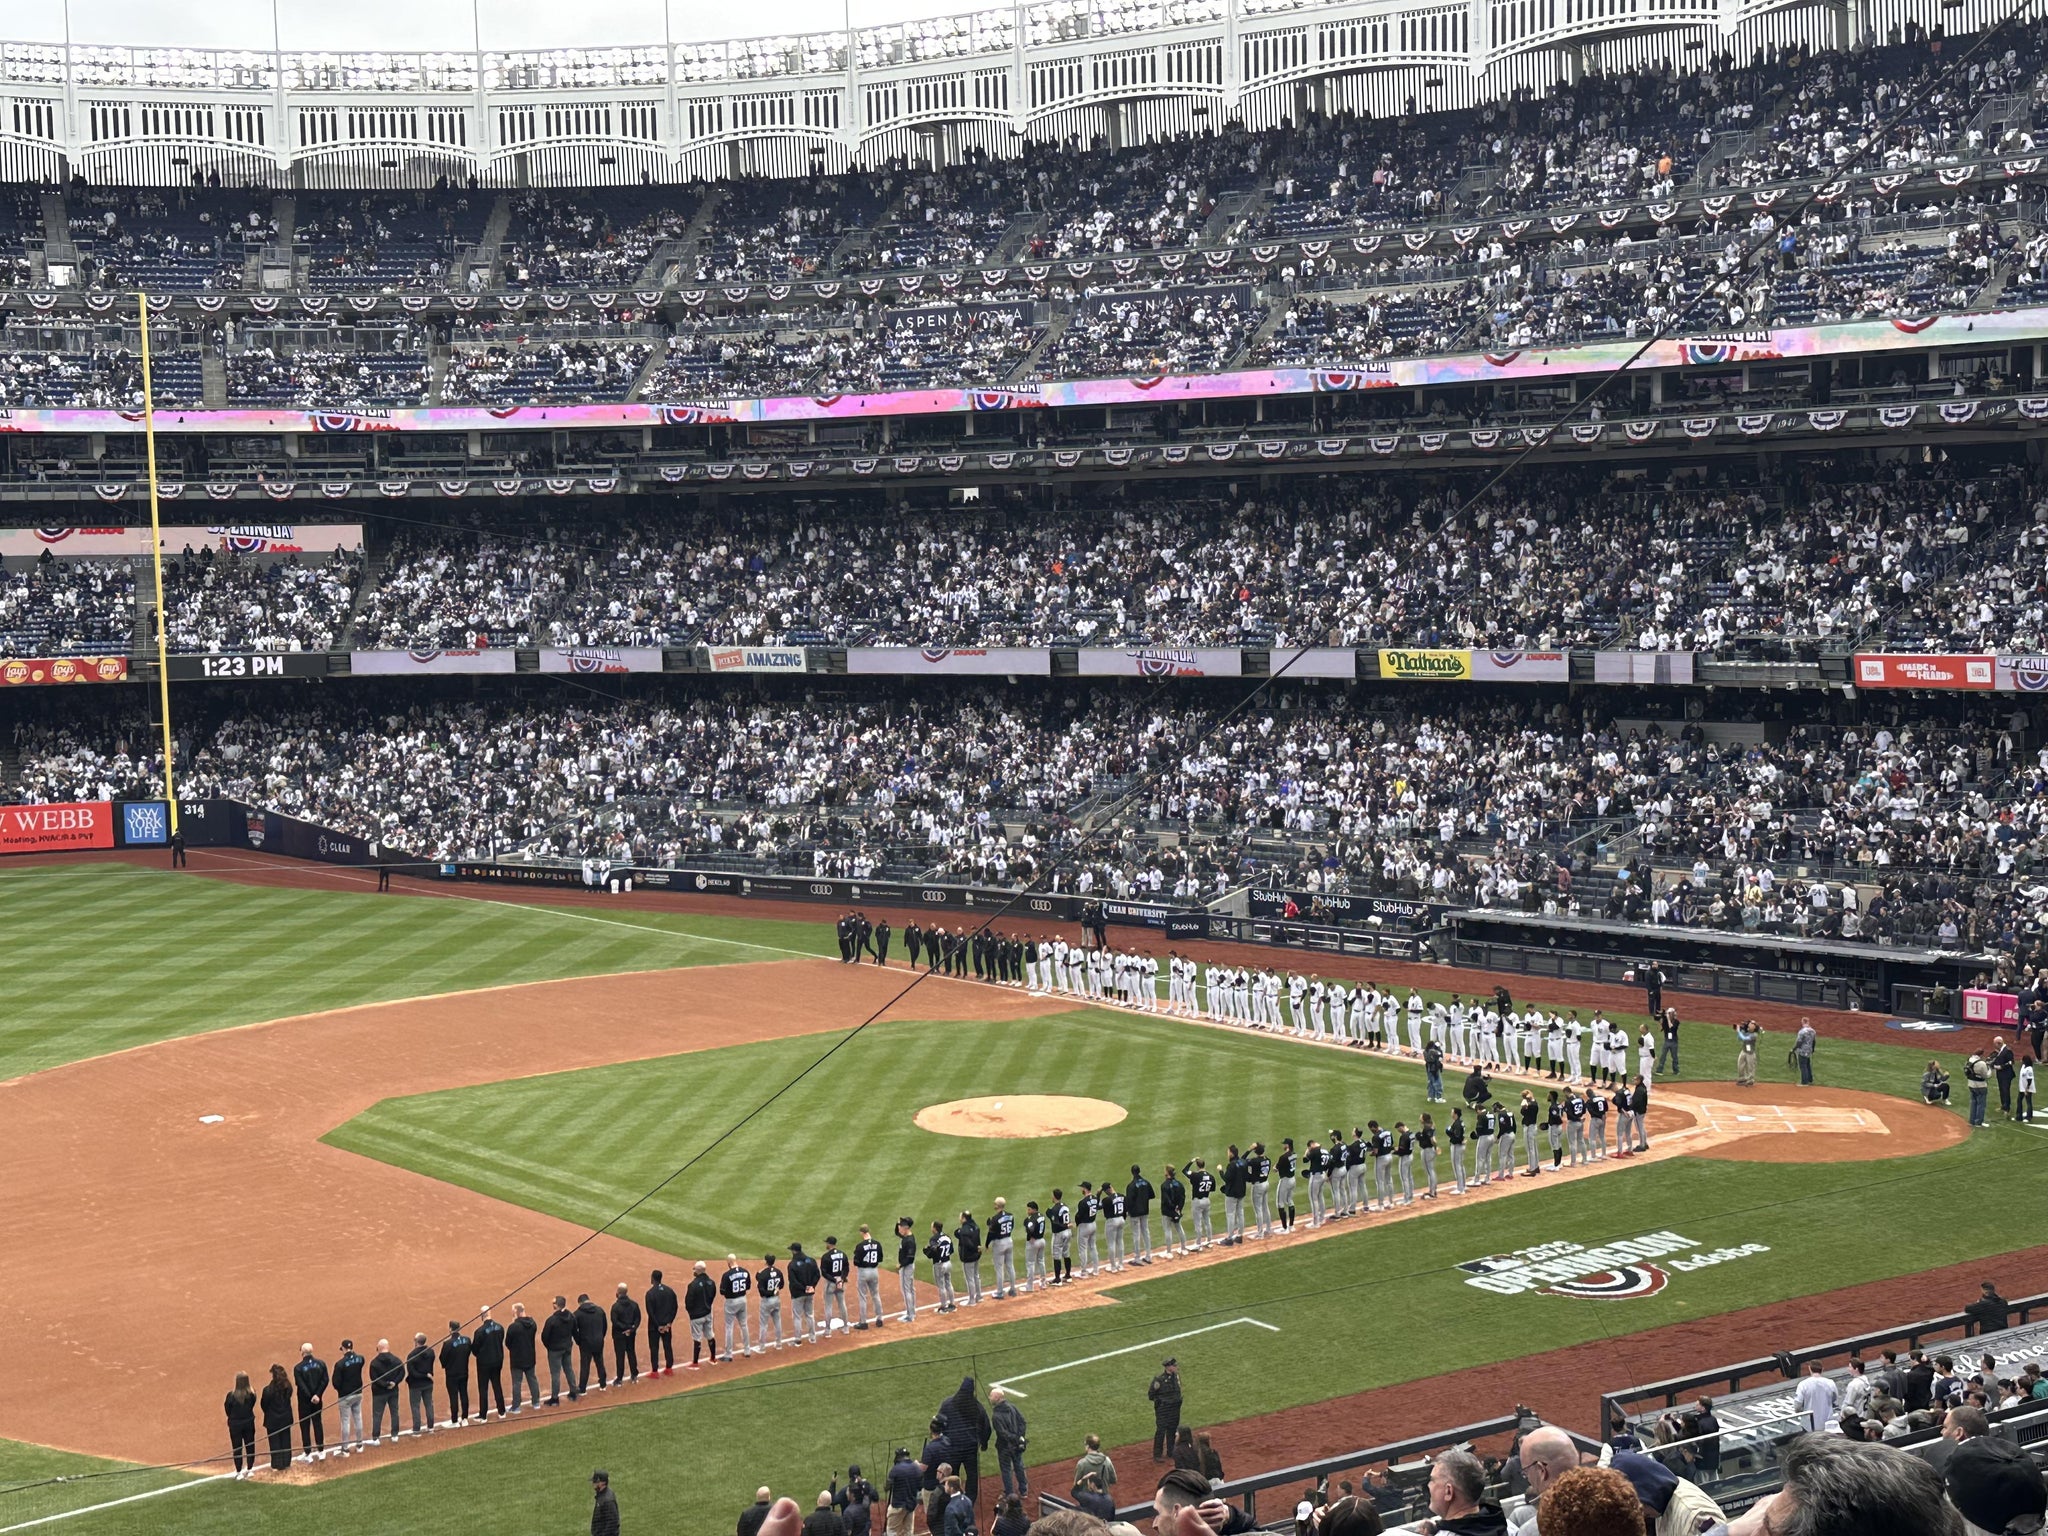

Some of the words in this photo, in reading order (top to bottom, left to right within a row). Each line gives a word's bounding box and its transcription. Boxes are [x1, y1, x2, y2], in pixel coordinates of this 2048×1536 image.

[1099, 299, 1155, 315] ASPN
[895, 314, 947, 329] ASPEN
[968, 308, 1022, 322] VOA
[202, 657, 246, 676] 1:23
[252, 656, 284, 675] PM
[746, 653, 802, 667] AMAZING
[1386, 651, 1464, 673] Nathan's
[131, 808, 159, 818] NEW
[184, 804, 204, 815] 314
[15, 809, 94, 831] WEBB
[127, 817, 163, 828] YORK
[132, 827, 160, 839] LIFE
[1253, 890, 1287, 903] StubHu
[1108, 904, 1127, 915] KEAN
[1127, 906, 1168, 919] UNIVERSITY
[1372, 901, 1413, 915] StubHub
[1971, 1000, 1983, 1014] T
[1198, 1181, 1212, 1192] 26
[1114, 1203, 1124, 1214] 19
[1000, 1222, 1012, 1235] 56
[863, 1251, 878, 1263] 48
[939, 1244, 951, 1257] 72
[1667, 1242, 1771, 1272] Adobe
[832, 1260, 843, 1273] 81
[1463, 1247, 1645, 1294] OPENING
[1603, 1230, 1702, 1257] DAY
[732, 1279, 746, 1293] 85
[1930, 1343, 2045, 1400] elome
